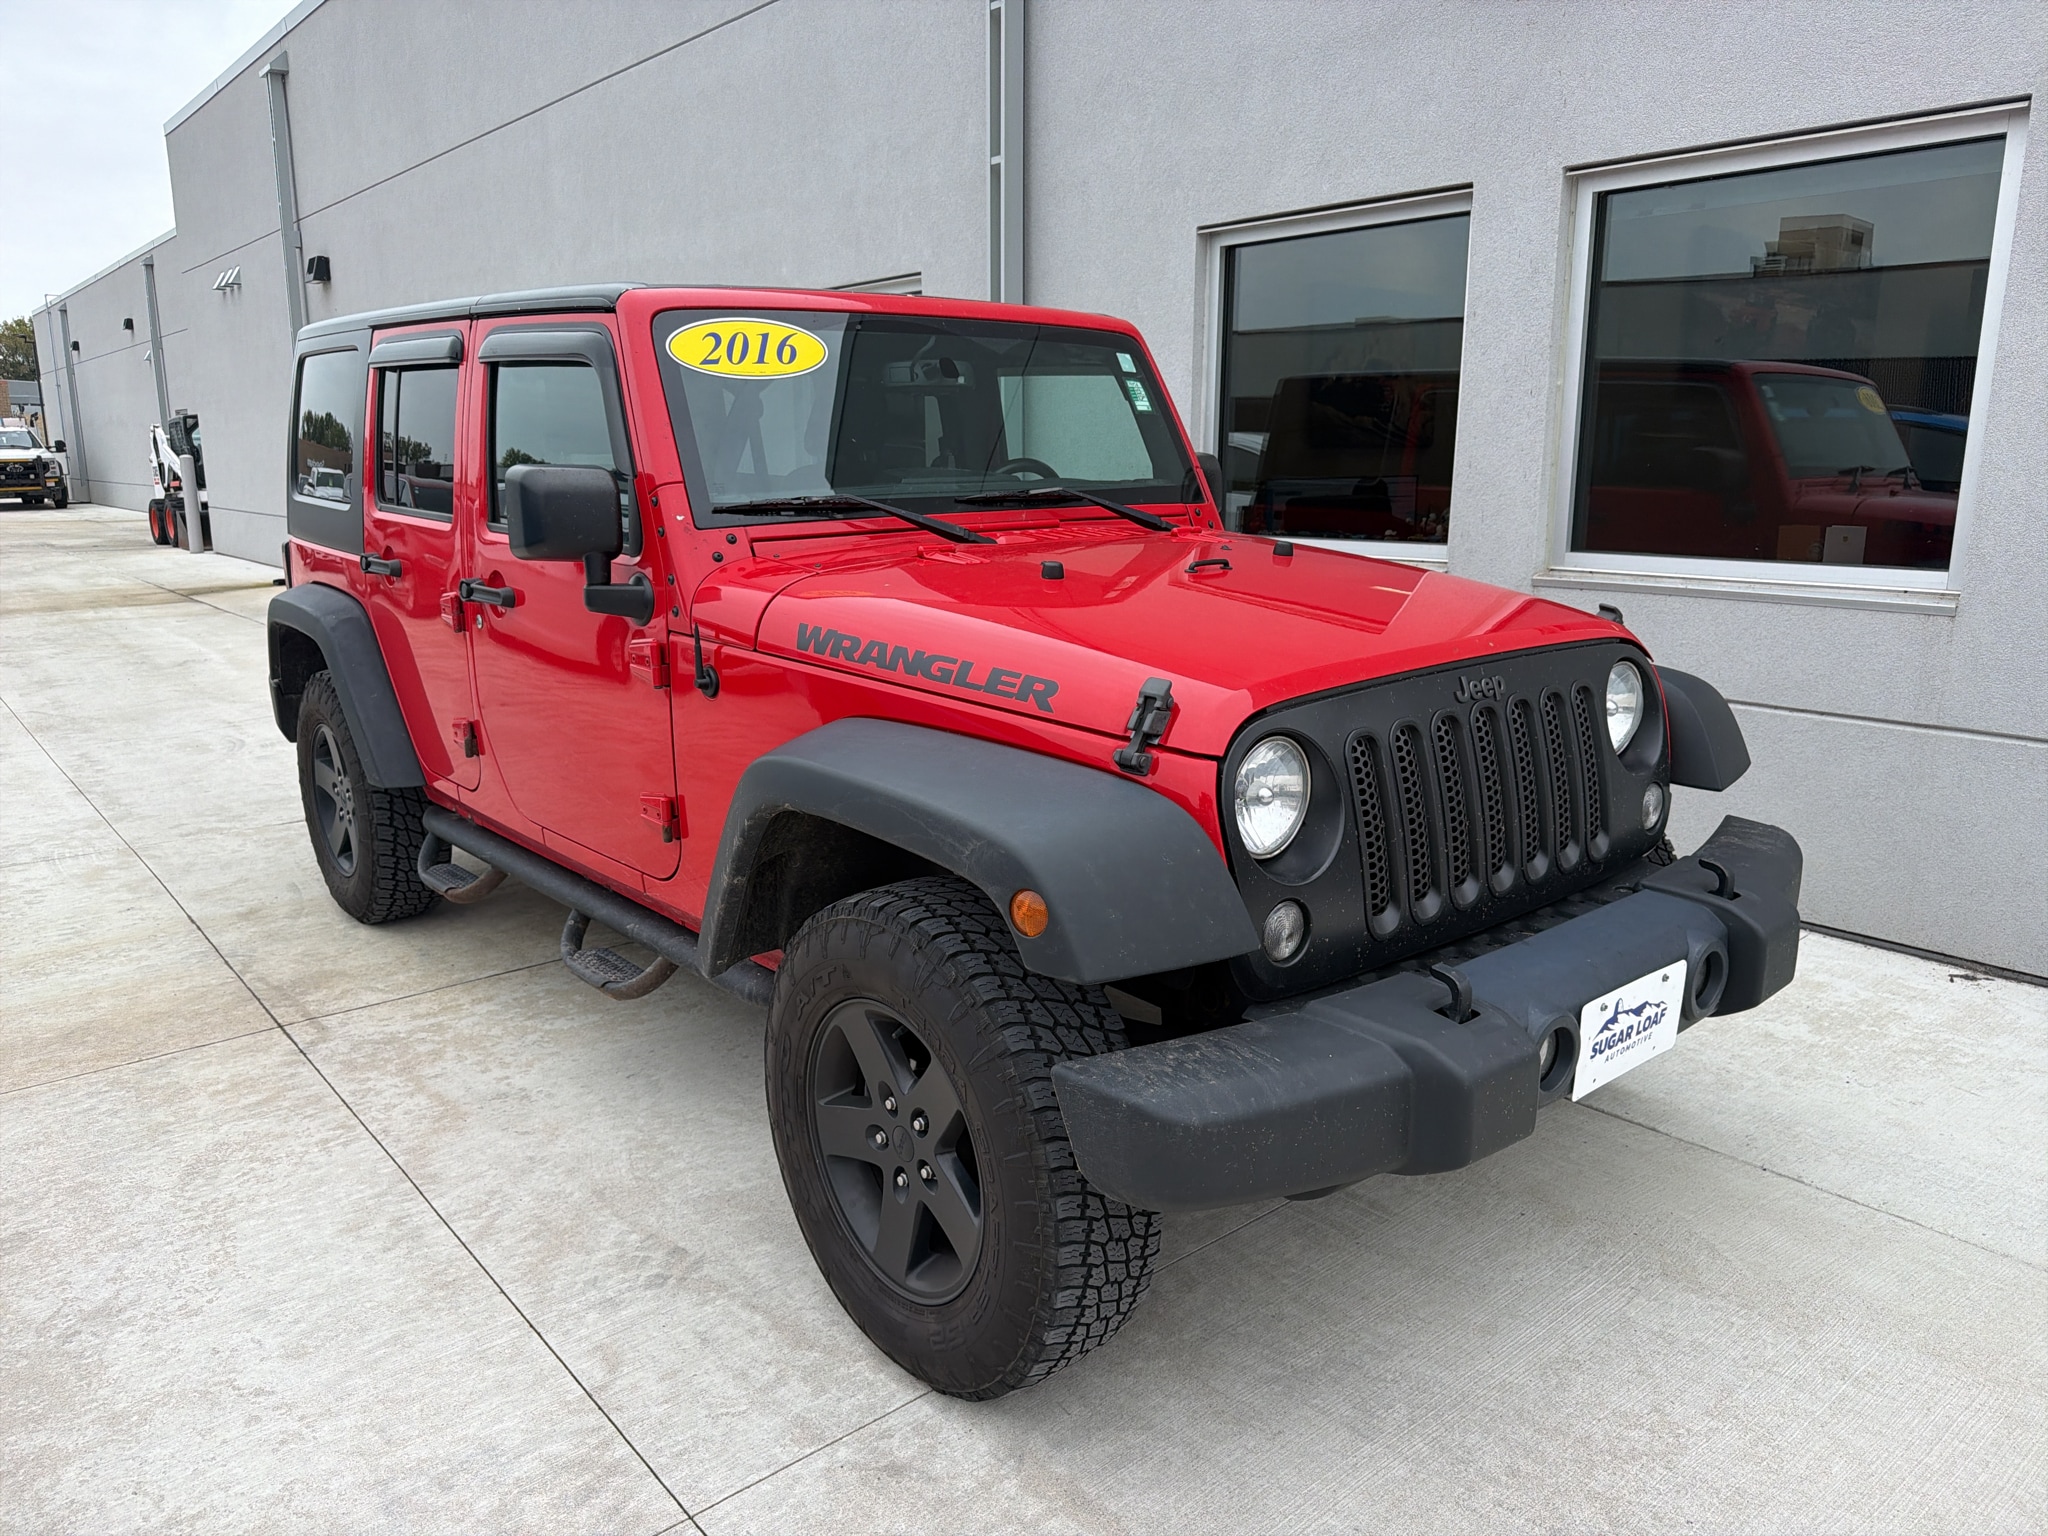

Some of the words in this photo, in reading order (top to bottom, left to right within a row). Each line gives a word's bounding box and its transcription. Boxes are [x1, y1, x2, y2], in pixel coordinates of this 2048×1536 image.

[699, 332, 798, 366] 2016
[796, 622, 1060, 714] WRANGLER
[1454, 675, 1507, 704] Jeep
[1589, 1024, 1635, 1060] SUGAR
[1635, 1006, 1668, 1037] LOAF
[1604, 1031, 1653, 1064] AUTOMOTIVE
